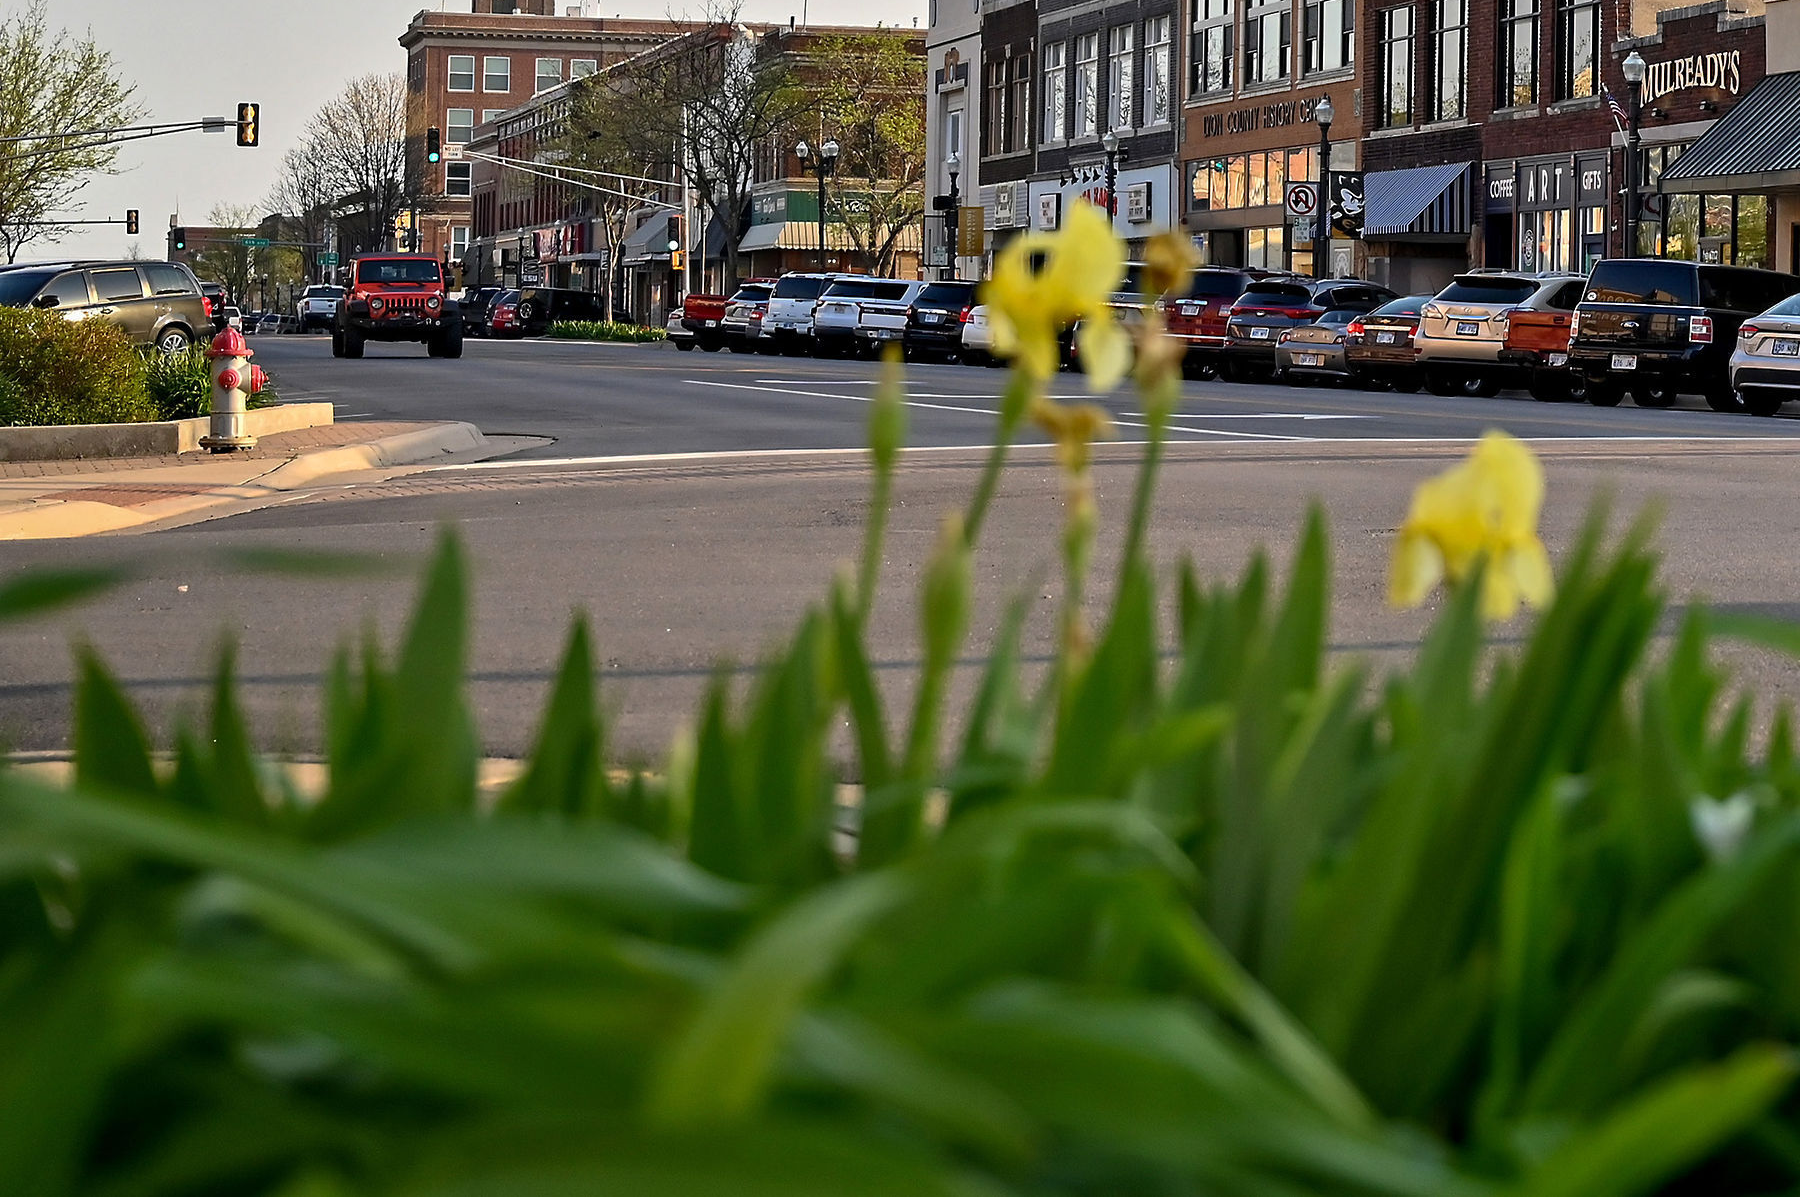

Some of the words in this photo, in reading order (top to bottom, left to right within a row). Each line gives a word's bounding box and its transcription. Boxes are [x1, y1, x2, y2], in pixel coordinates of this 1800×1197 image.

[1640, 49, 1740, 109] MULREADY'S
[1203, 113, 1223, 139] LYON
[1227, 106, 1260, 135] COUNTY
[1263, 101, 1297, 129] HISTORY
[1490, 178, 1513, 198] COFFEE
[1582, 170, 1602, 190] GIFTS
